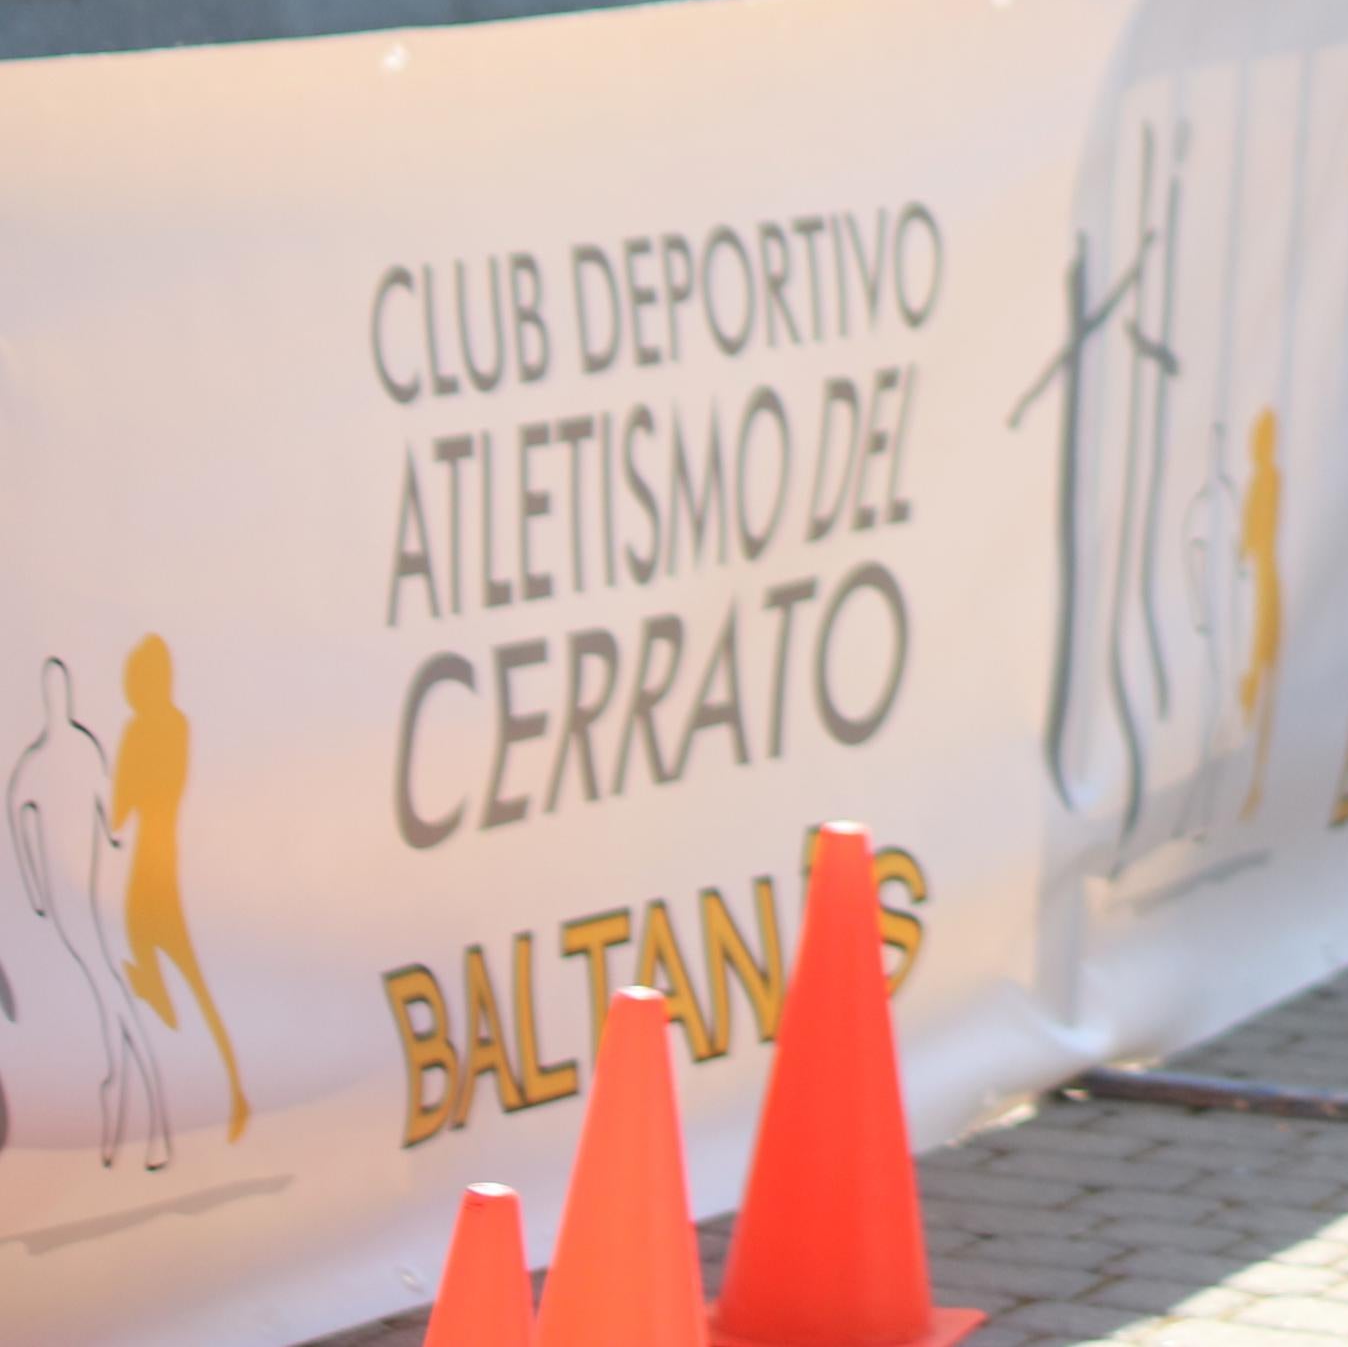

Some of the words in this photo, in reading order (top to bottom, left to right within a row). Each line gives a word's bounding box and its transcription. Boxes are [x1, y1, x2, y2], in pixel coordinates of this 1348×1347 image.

[369, 250, 552, 406] CLUB
[569, 199, 945, 377] DEPORTIVO
[385, 384, 792, 629] ATLETISMO
[804, 361, 918, 544] DEL
[393, 559, 910, 851] CERRATO
[381, 822, 928, 1149] BALTANS
